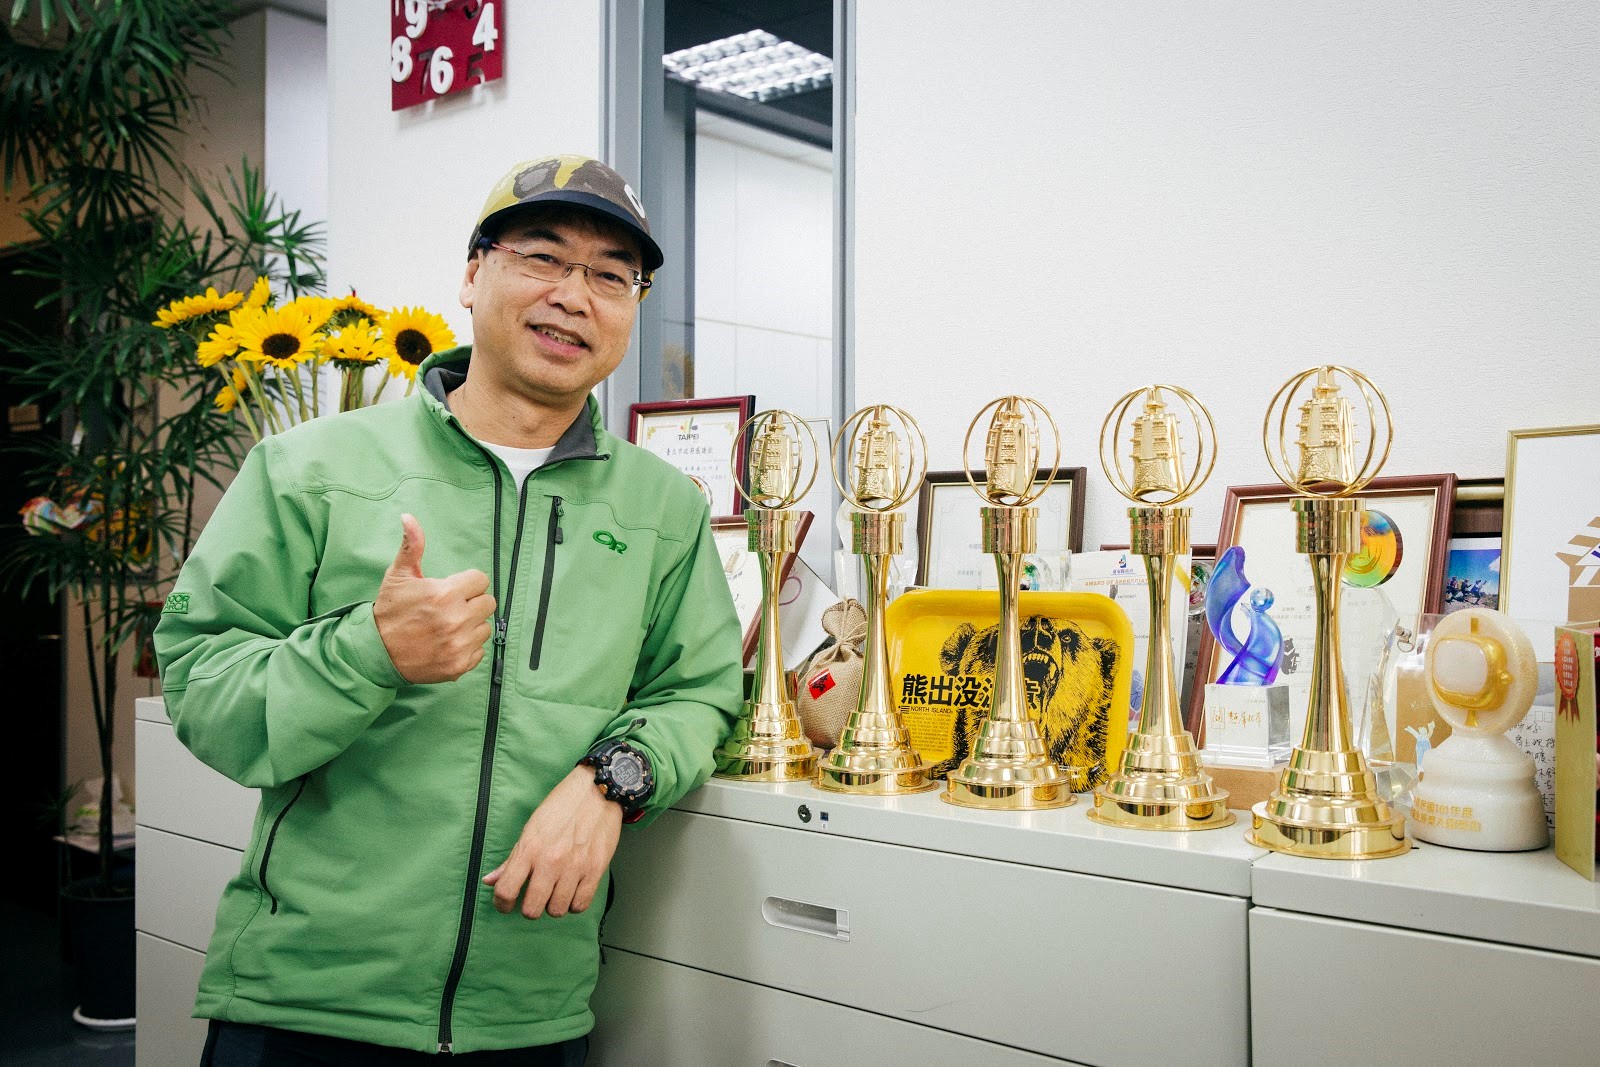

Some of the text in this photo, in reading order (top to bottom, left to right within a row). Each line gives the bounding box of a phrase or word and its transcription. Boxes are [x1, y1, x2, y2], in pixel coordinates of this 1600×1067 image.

[404, 0, 428, 38] 9
[472, 2, 498, 51] 4
[391, 36, 413, 82] 8
[430, 46, 454, 94] 6
